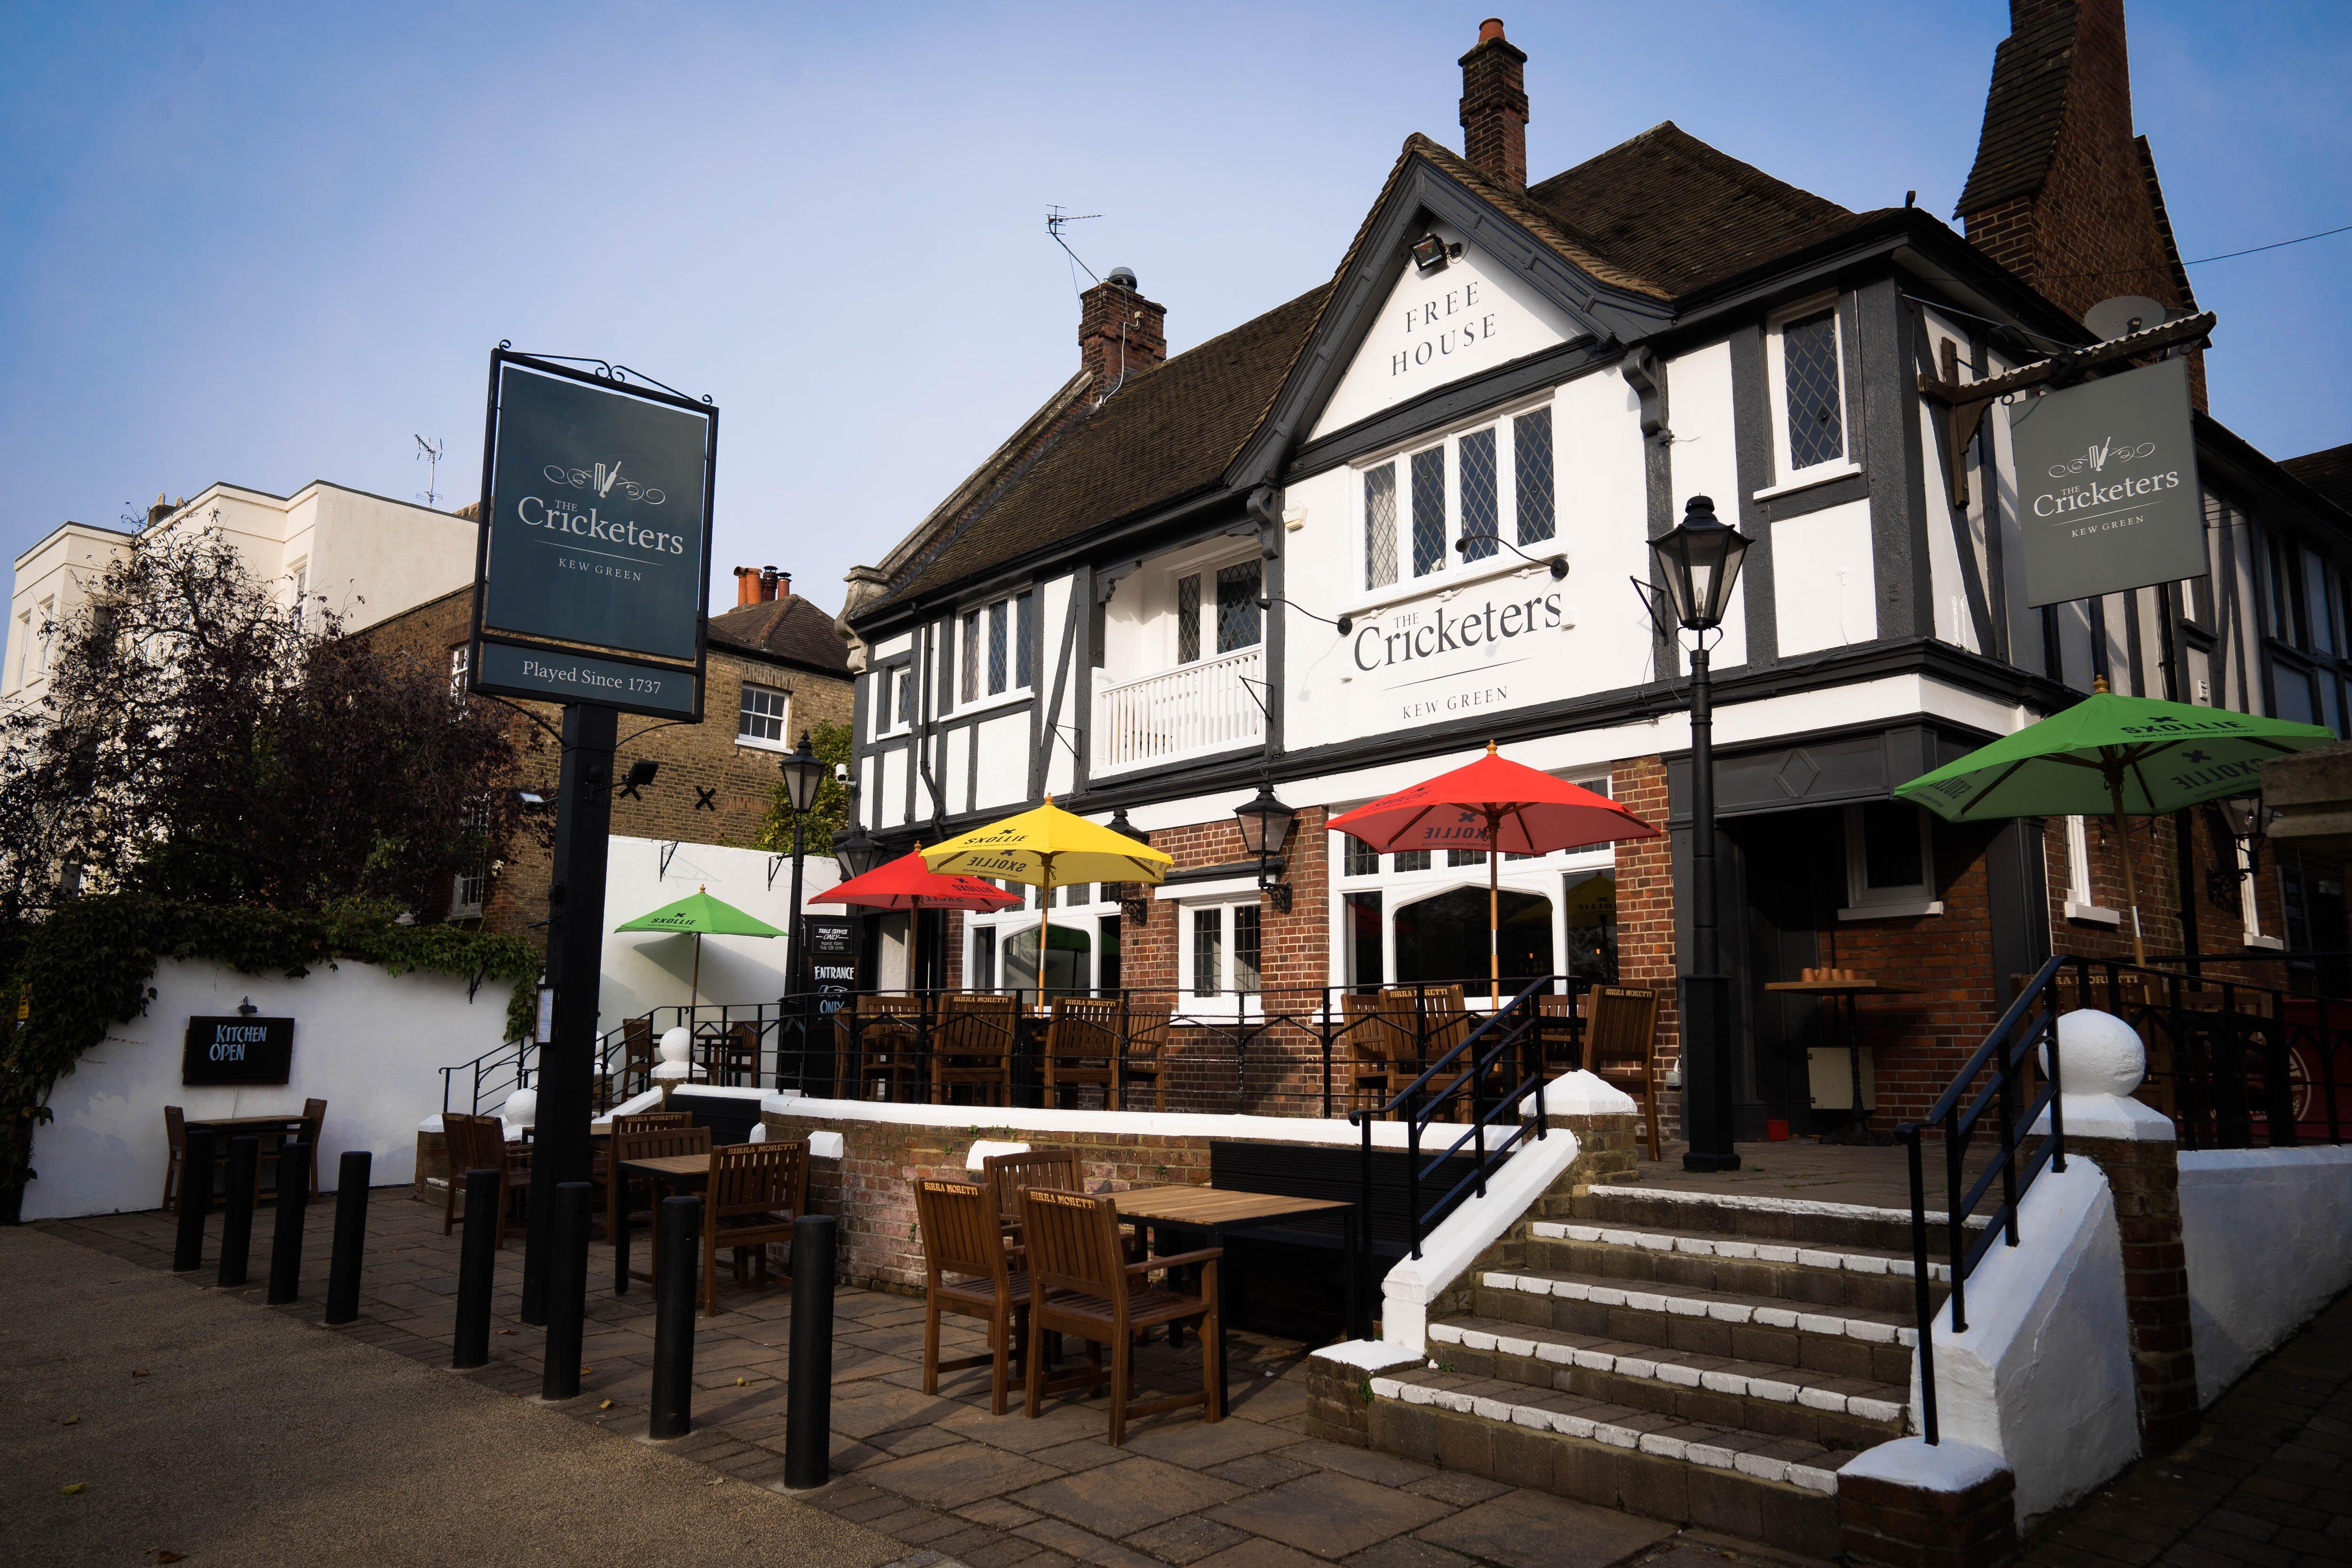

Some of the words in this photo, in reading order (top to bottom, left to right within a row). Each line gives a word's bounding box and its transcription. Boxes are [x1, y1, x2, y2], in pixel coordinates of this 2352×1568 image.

[1405, 281, 1480, 333] FREE
[1391, 313, 1496, 376] HOUSE
[2034, 470, 2179, 517] Cricketers
[2061, 486, 2080, 495] THE
[555, 500, 578, 512] THE
[518, 496, 683, 555] Cricketers
[2072, 525, 2098, 537] KEW
[2102, 515, 2144, 531] GREEN
[558, 558, 590, 572] KEW
[595, 565, 642, 581] GREEN
[1393, 612, 1419, 629] THE
[1354, 592, 1562, 671] Cricketers
[523, 661, 577, 684] Played
[582, 670, 623, 689] Since
[628, 678, 661, 694] 1737
[1403, 700, 1439, 719] KEW
[1446, 686, 1508, 710] GREEN
[2120, 721, 2247, 733] SXOLLIE
[964, 836, 1029, 844] SXOLLIE
[814, 966, 855, 979] ENTRANCE
[820, 1000, 845, 1013] ONLY
[216, 1025, 267, 1043] KITCHEN
[210, 1043, 245, 1061] OPEN
[758, 1143, 797, 1152] MORETTI
[924, 1181, 945, 1192] BIRRA
[946, 1184, 978, 1195] MORETTI
[1030, 1191, 1055, 1203] BIRRA
[1057, 1195, 1096, 1210] MORETTI
